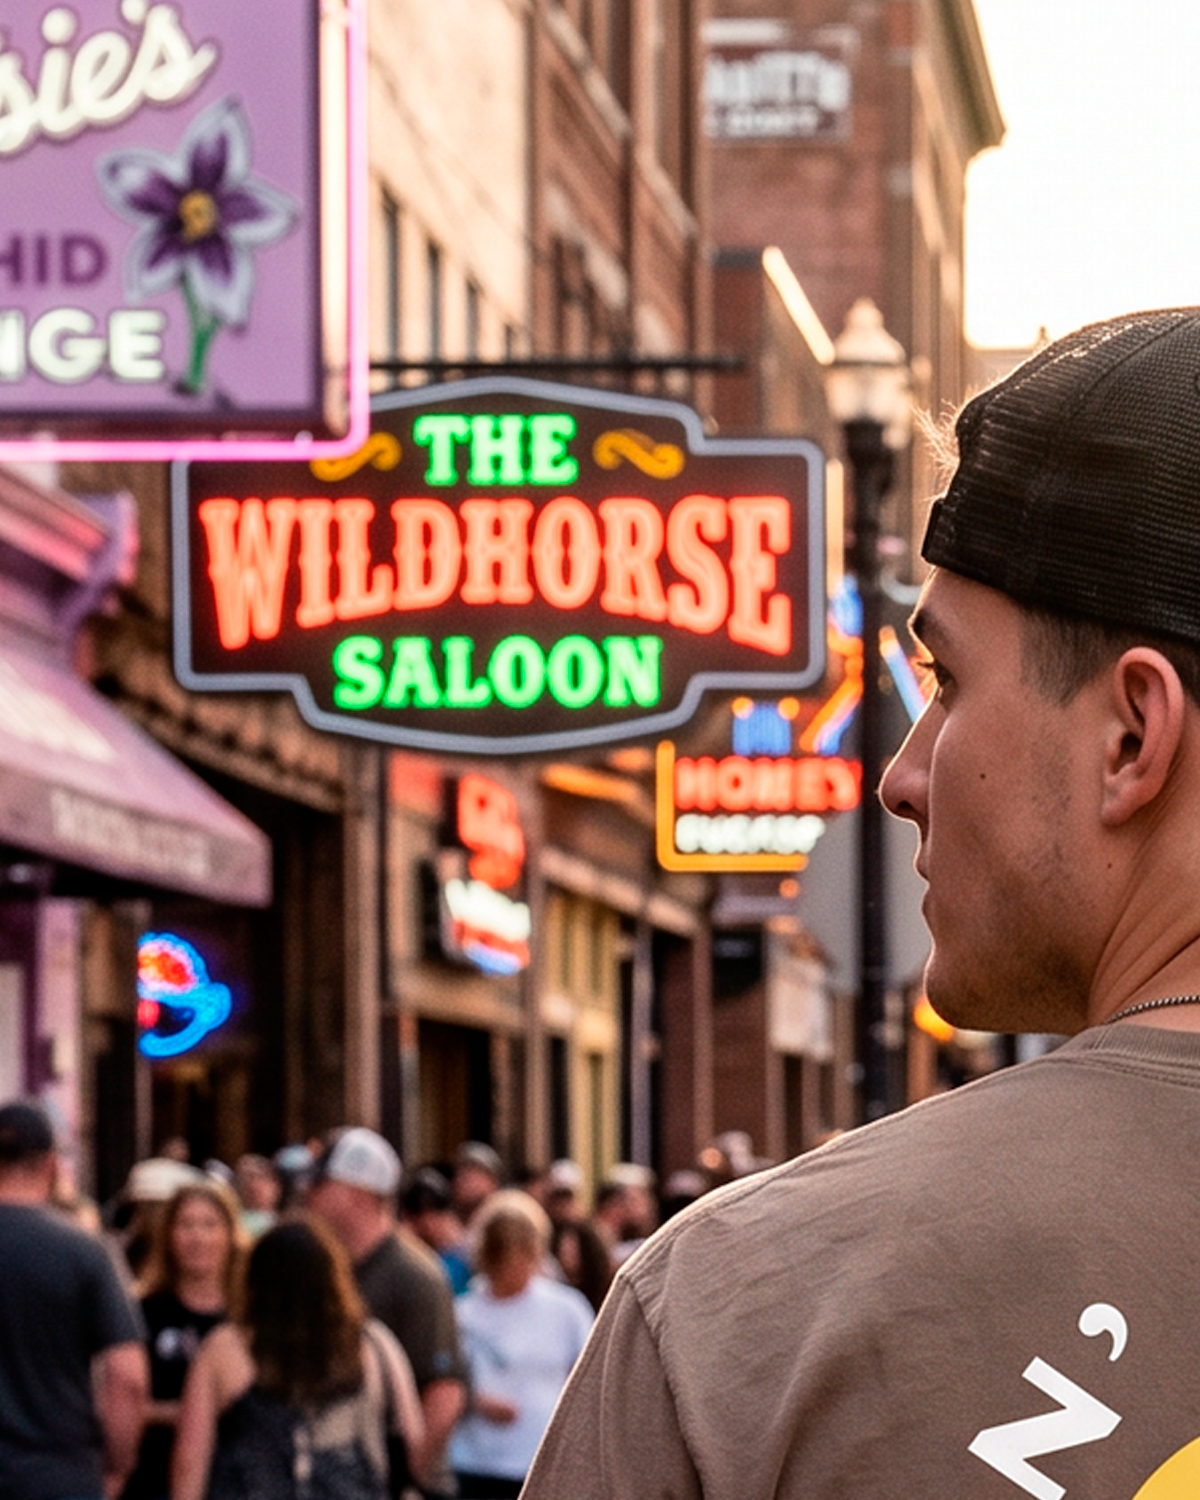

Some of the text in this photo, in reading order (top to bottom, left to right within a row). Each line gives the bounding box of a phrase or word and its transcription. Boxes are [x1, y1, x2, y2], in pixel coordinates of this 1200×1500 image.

[412, 412, 580, 487] THE
[198, 493, 793, 656] WILDHORSE
[332, 634, 664, 710] SALOON
